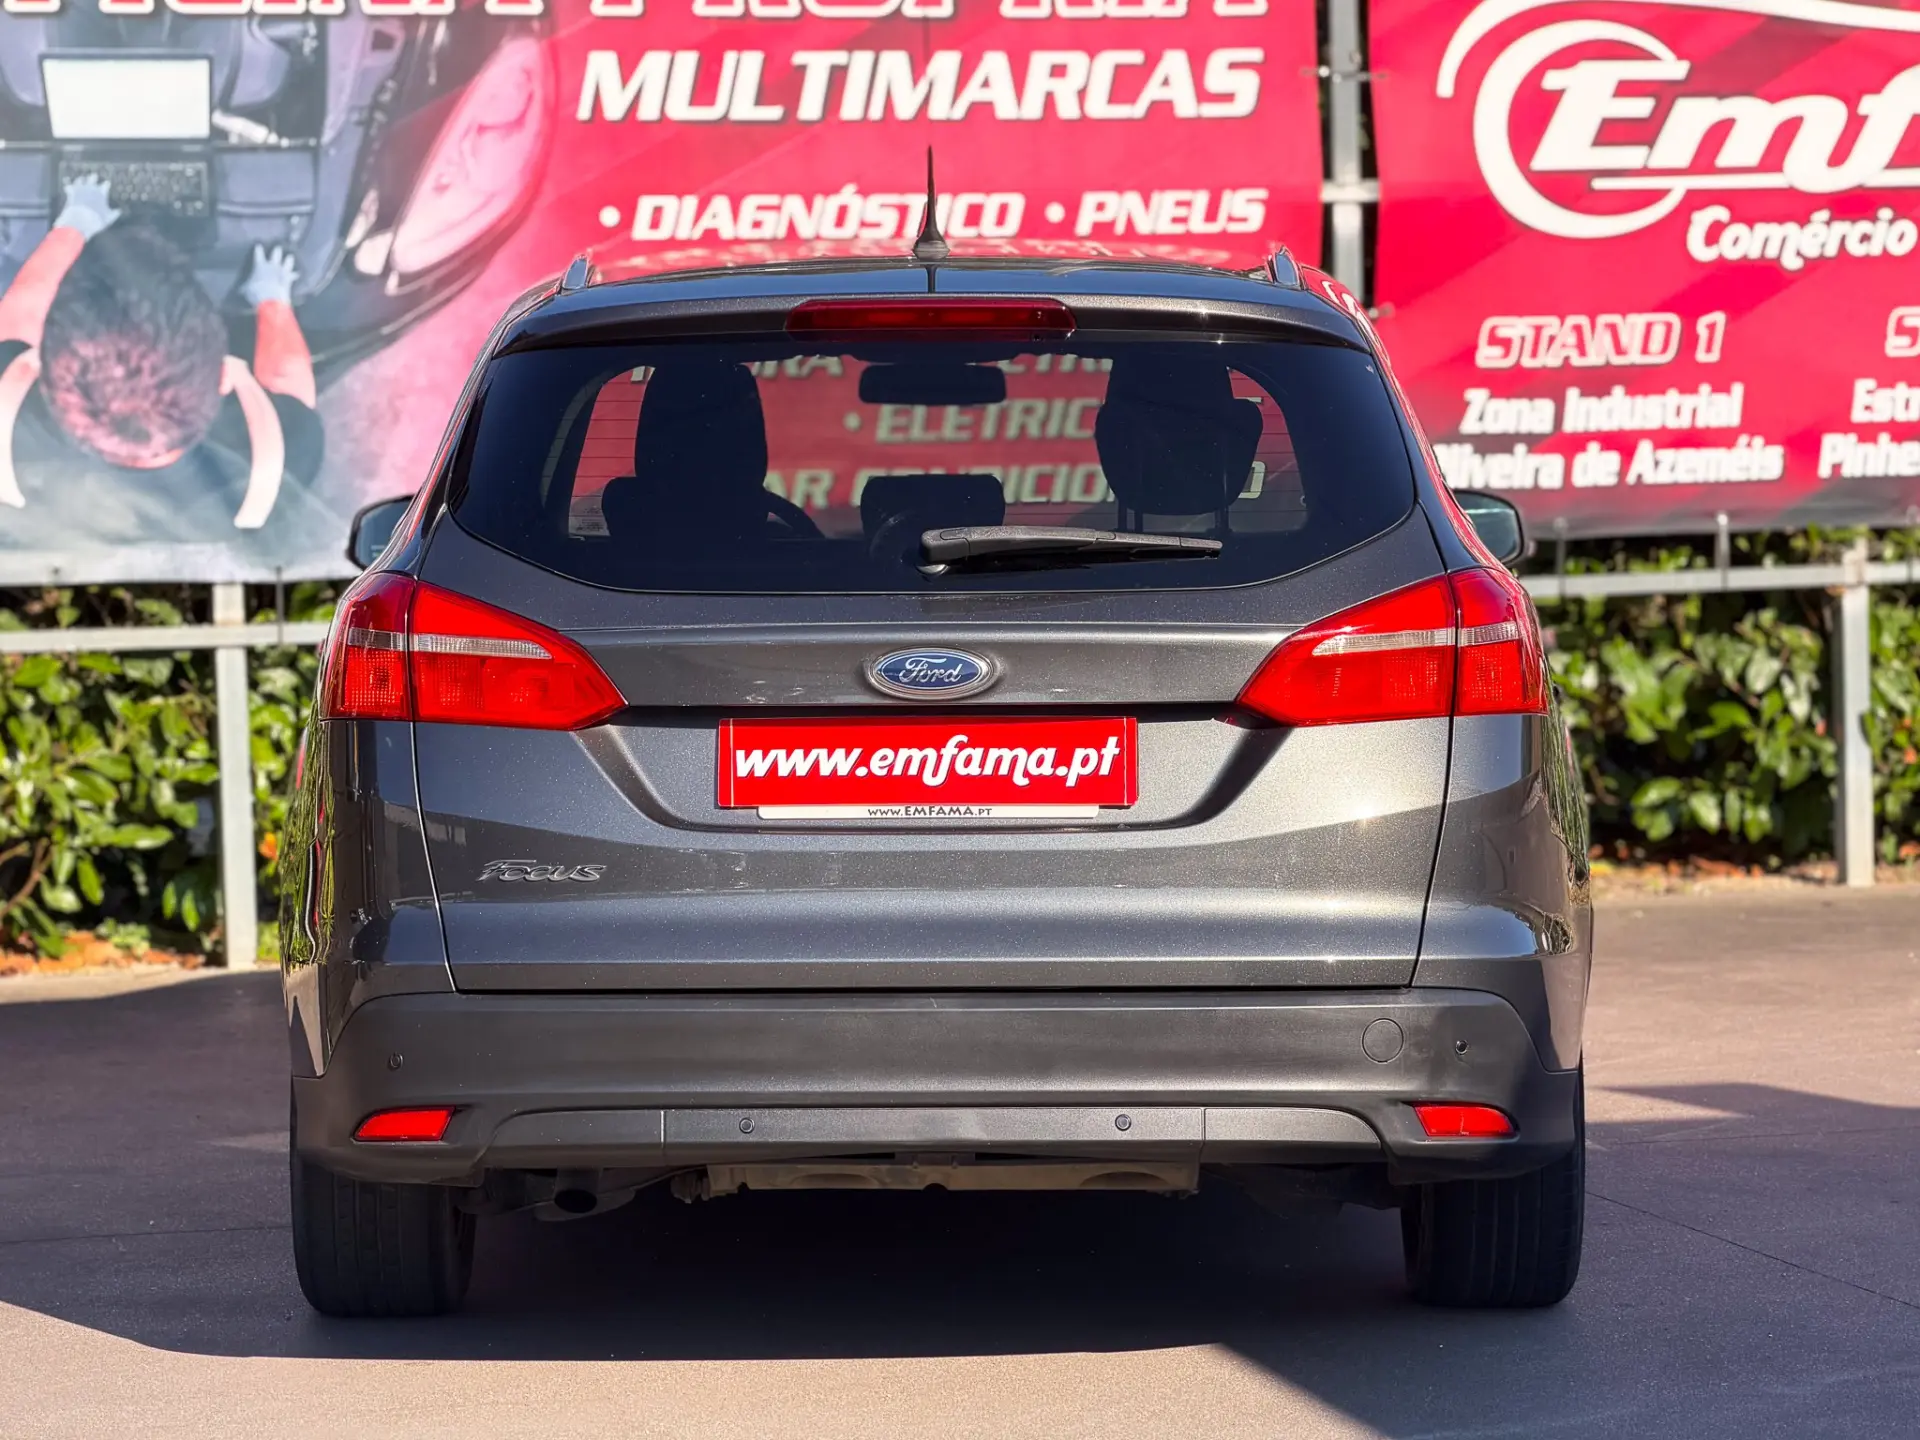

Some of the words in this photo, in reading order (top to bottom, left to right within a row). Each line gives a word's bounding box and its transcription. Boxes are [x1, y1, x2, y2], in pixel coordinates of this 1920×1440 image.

[576, 48, 1264, 122] MULTIMARCAS
[631, 184, 1025, 240] DIAGNÓSTICO
[1074, 188, 1269, 236] PNEUS
[1686, 205, 1918, 271] Comércio
[1475, 312, 1681, 368] STAND
[1695, 311, 1726, 363] 1
[1459, 388, 1556, 434] Zona
[1562, 383, 1745, 433] Industrial
[1571, 441, 1621, 488] de
[1625, 434, 1784, 485] Azeméis
[898, 657, 963, 683] Ford
[735, 734, 1121, 787] www.emfama.pt
[476, 858, 607, 882] Focus
